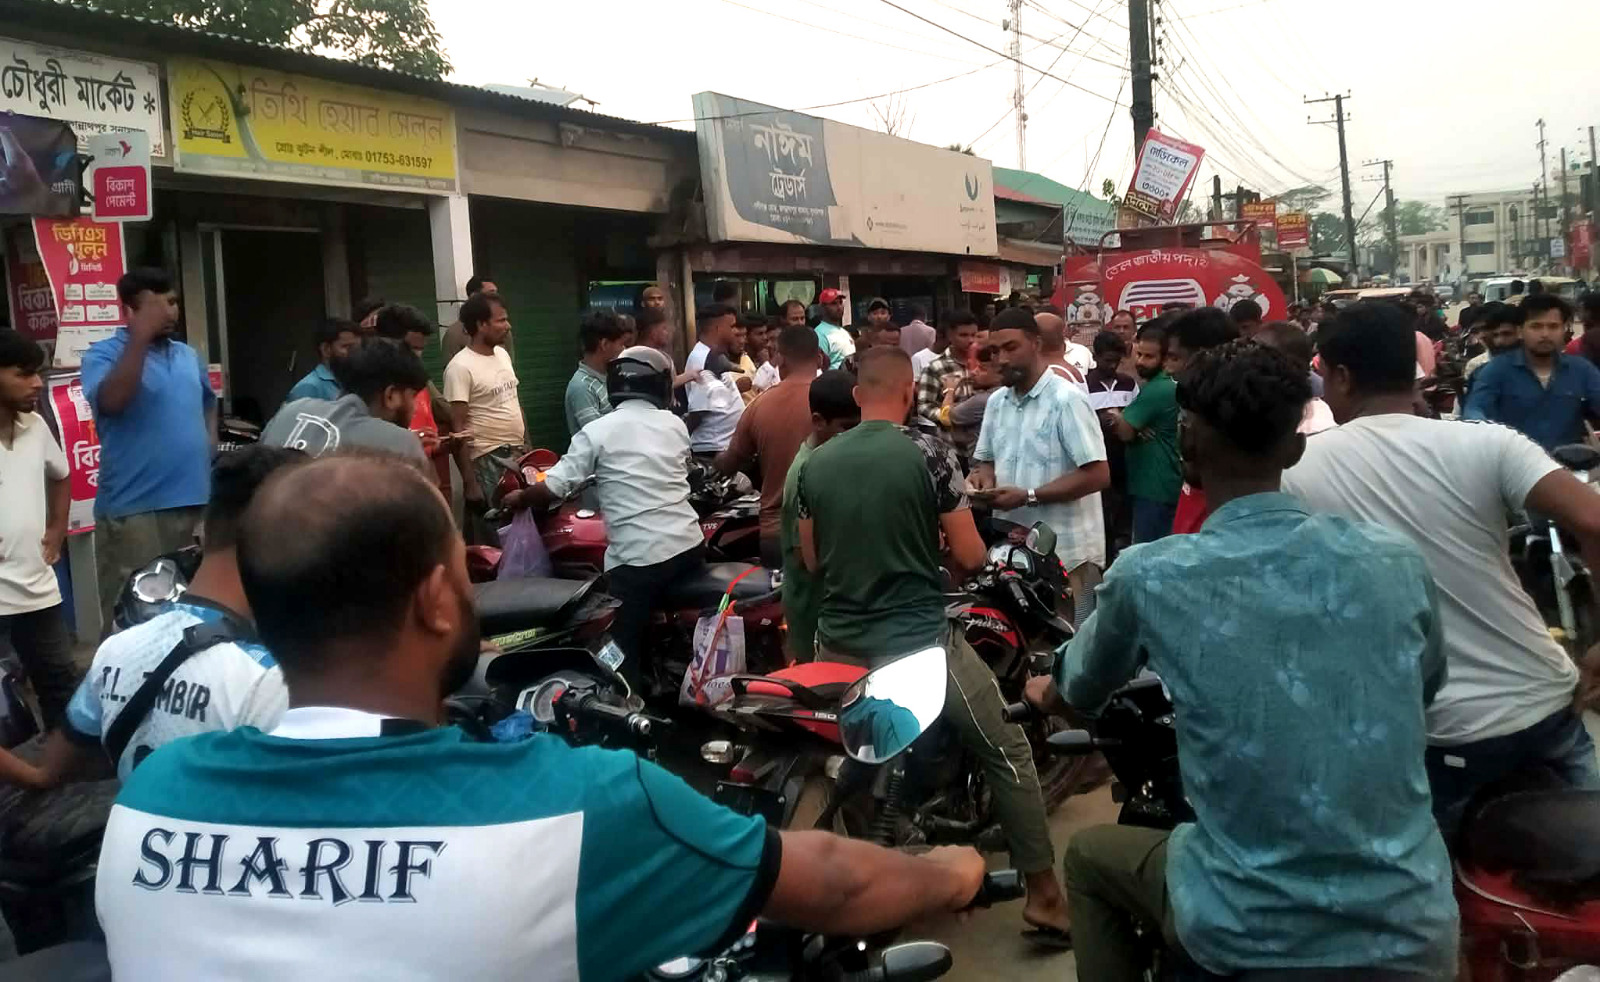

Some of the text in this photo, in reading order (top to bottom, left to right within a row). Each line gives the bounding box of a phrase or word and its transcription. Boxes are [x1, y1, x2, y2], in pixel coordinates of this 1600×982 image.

[2, 51, 136, 114] চৌধুরী মার্কেট
[249, 77, 308, 127] তিথি
[388, 111, 443, 148] সেলুন
[749, 117, 813, 167] নাঈম
[365, 151, 433, 169] 01753-631597
[1150, 146, 1189, 168] মেডিকেল
[106, 176, 135, 191] বিকাশ
[769, 167, 807, 201] ট্রেডার্স
[105, 192, 137, 207] পেমেন্ট
[1105, 259, 1131, 280] তেল
[1133, 249, 1170, 266] জাতীয়
[18, 283, 53, 311] বিকা
[702, 522, 719, 531] TVS
[143, 671, 211, 723] TMBIR
[814, 711, 837, 720] 150
[132, 827, 447, 908] SHARIF
